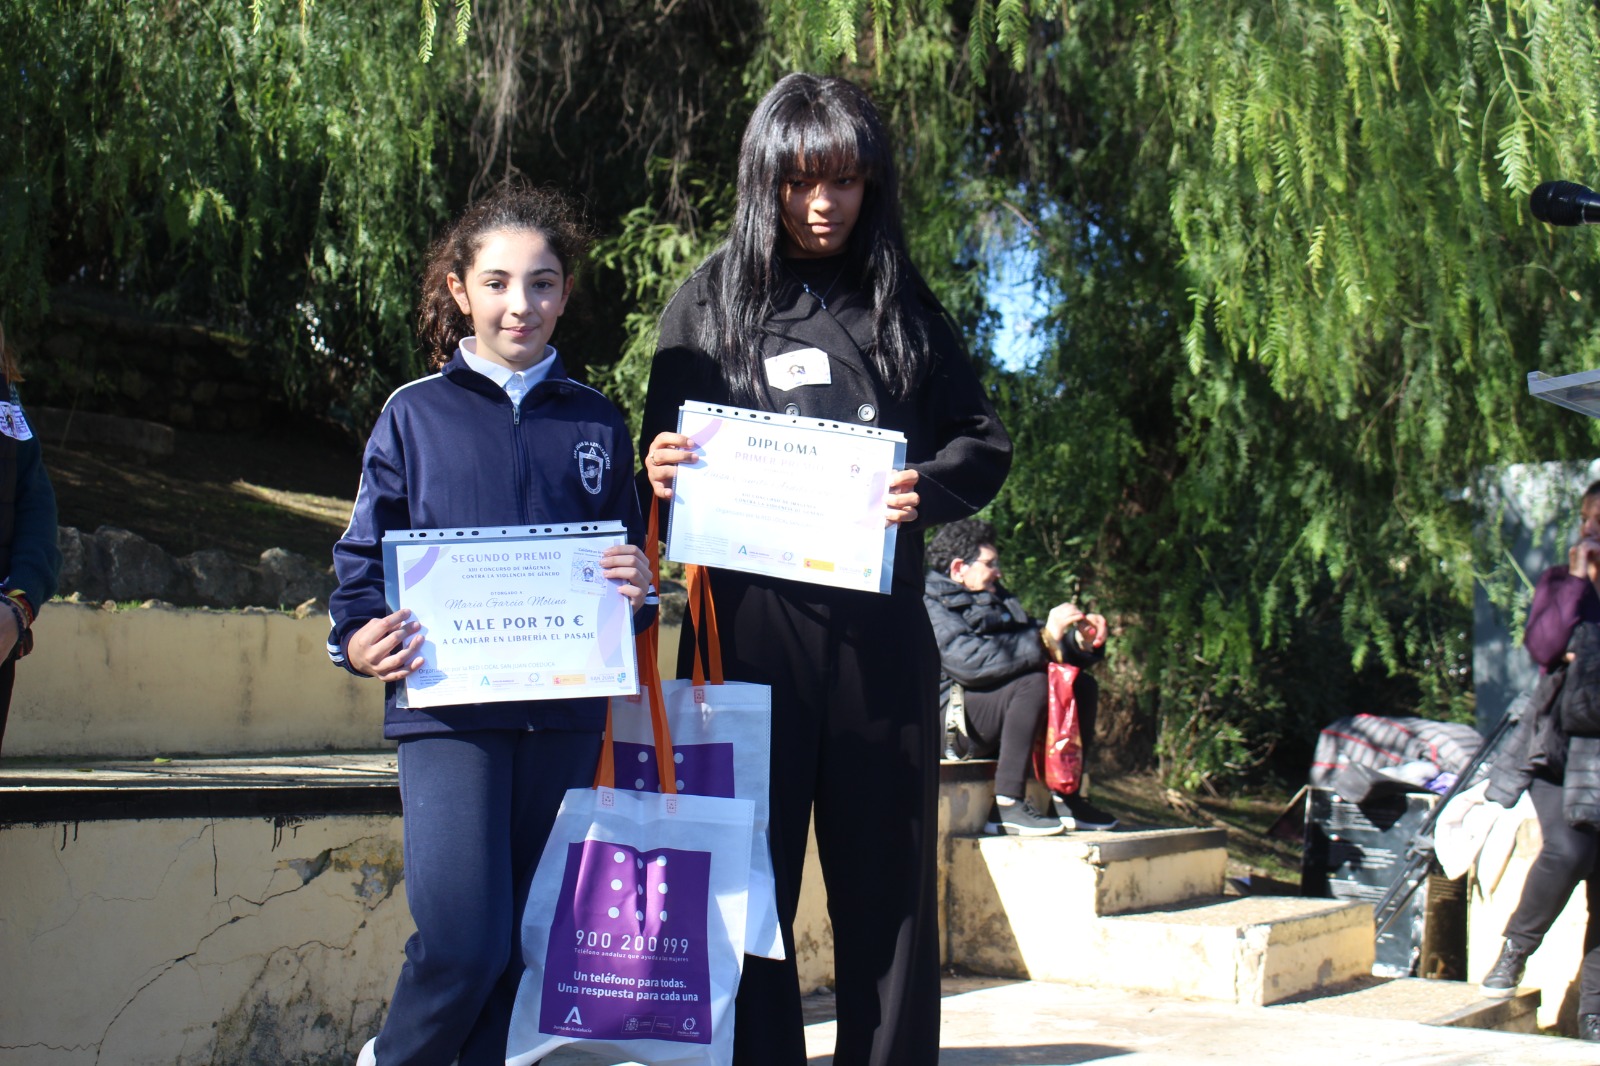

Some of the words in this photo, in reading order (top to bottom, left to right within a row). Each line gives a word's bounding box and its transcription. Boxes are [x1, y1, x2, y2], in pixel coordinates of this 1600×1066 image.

[747, 436, 818, 457] DIPLOMA
[734, 451, 776, 465] PRIMER
[451, 552, 510, 564] SEGUNDO
[515, 551, 562, 562] PREMIO
[527, 595, 568, 607] Molina
[453, 617, 496, 631] VALE
[502, 616, 538, 630] POR
[544, 615, 565, 628] 70
[573, 614, 585, 627] €
[451, 636, 491, 645] CANJEAR
[493, 635, 505, 643] EN
[507, 632, 548, 643] LIBRERÍA
[550, 632, 561, 640] EL
[564, 631, 596, 640] PASAJE
[576, 930, 612, 949] 900
[620, 934, 657, 952] 200
[663, 937, 689, 954] 999
[574, 947, 600, 956] Teléfono
[601, 950, 627, 959] andaluz
[627, 953, 640, 961] que
[640, 954, 658, 962] ayuda
[668, 956, 689, 964] mujeres
[573, 971, 588, 982] Un
[589, 971, 636, 986] teléfono
[637, 978, 659, 989] para
[660, 977, 687, 989] todas.
[557, 982, 579, 994] Una
[581, 986, 634, 1000] respuesta
[636, 990, 659, 1002] para
[660, 991, 680, 1001] cada
[682, 993, 699, 1002] una
